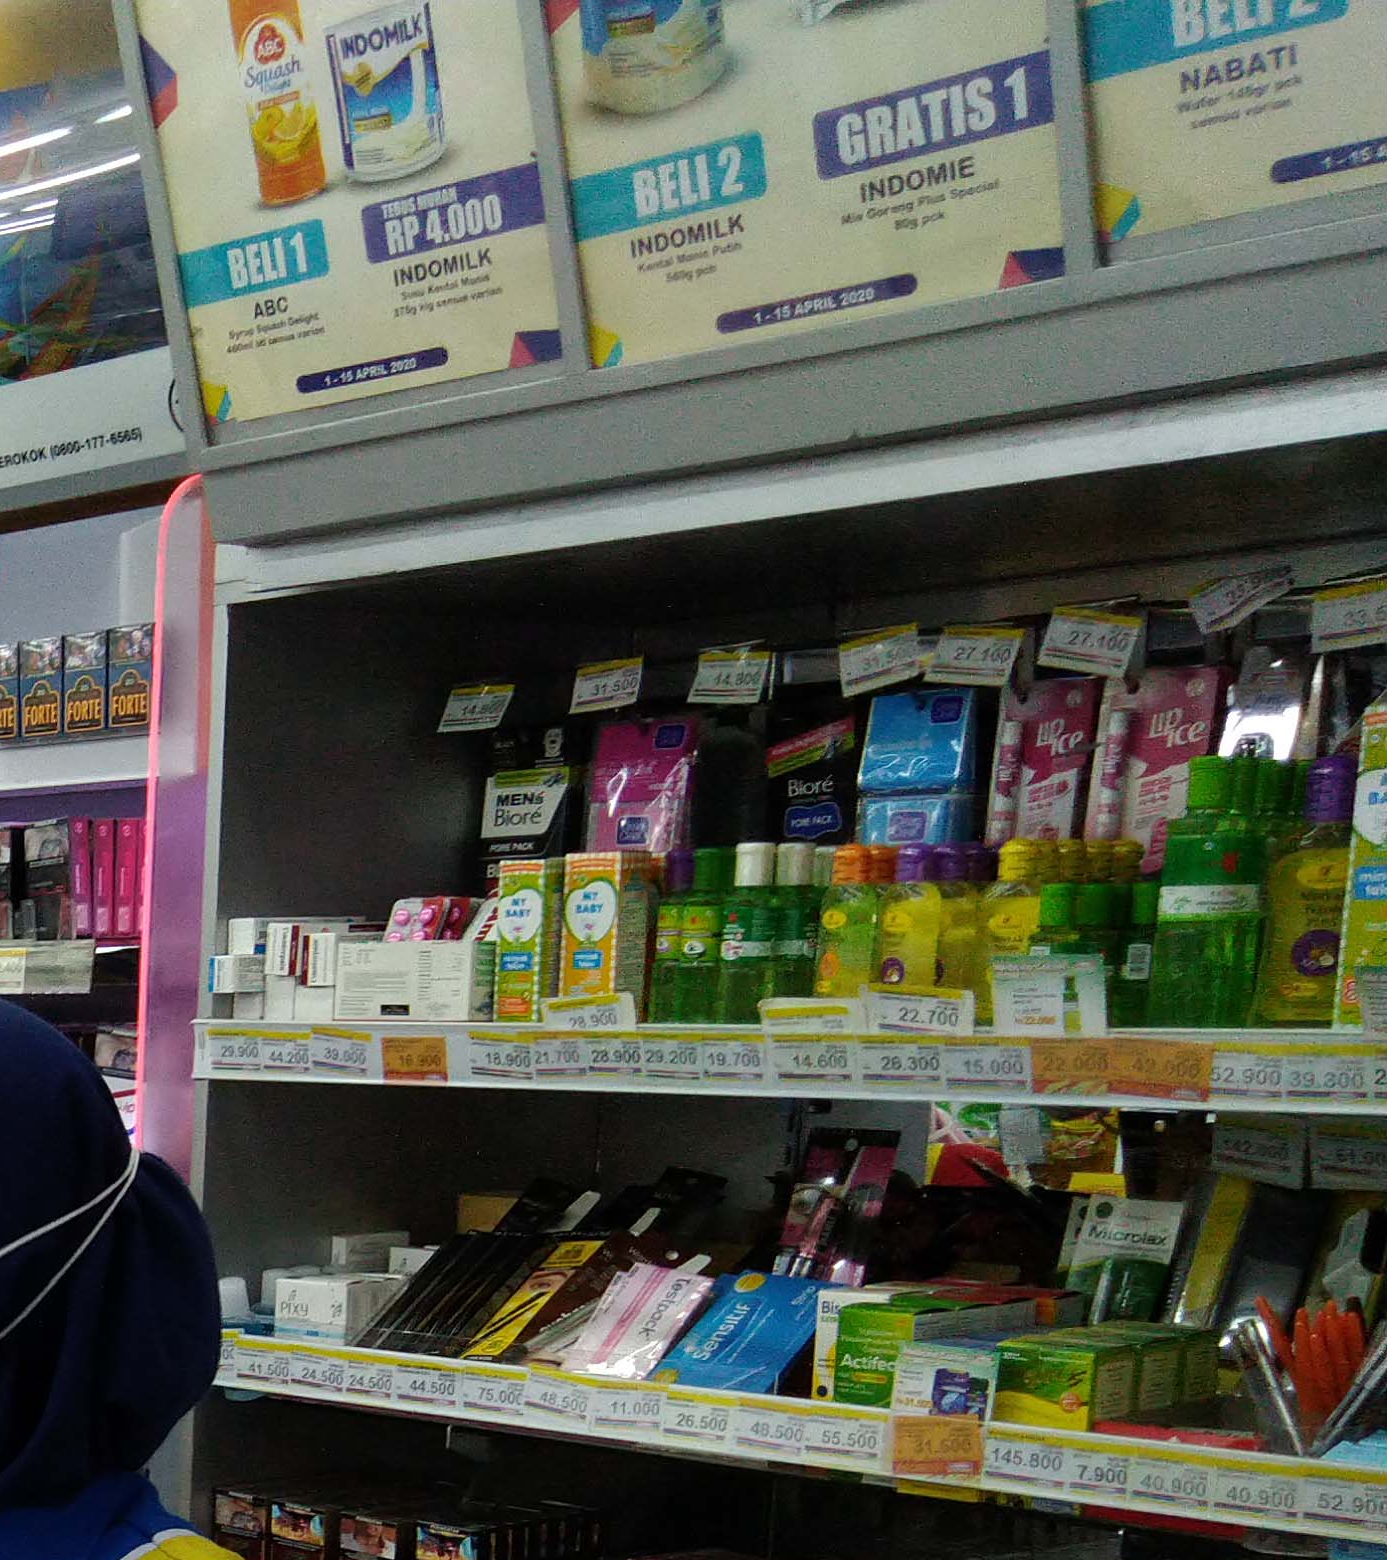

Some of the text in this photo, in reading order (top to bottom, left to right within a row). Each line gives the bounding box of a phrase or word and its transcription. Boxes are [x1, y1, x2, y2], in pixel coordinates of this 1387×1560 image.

[341, 13, 423, 59] INDOMILK
[245, 54, 300, 92] Squash
[1180, 42, 1299, 94] NABATI
[836, 66, 1028, 167] GRATIS 1
[631, 146, 745, 219] BELI 2
[860, 155, 976, 203] INDOMIE
[384, 194, 504, 256] RP 4.000
[629, 213, 746, 259] INDOMILK
[226, 231, 309, 290] BELI 1
[393, 247, 494, 287] INDOMILK
[253, 296, 289, 321] ABC
[772, 305, 793, 321] 15
[793, 298, 837, 316] APRIL
[840, 287, 876, 309] 2020
[355, 363, 390, 380] APRIL
[390, 357, 418, 371] 2020
[24, 702, 58, 725] FORTE
[67, 698, 102, 722] FORTE
[112, 692, 147, 717] FORTE
[493, 806, 543, 828] Bioré
[898, 1003, 959, 1027] 22.700
[268, 1049, 310, 1066] 44.200
[791, 1053, 848, 1070] 14.600
[963, 1057, 1025, 1075] 15.000
[1086, 1222, 1168, 1249] Microlax
[638, 1277, 692, 1339] Testpack
[300, 1366, 344, 1386] 24.500
[409, 1378, 456, 1396] 44.500
[608, 1399, 661, 1418] 11.000
[675, 1412, 729, 1433] 26.500
[820, 1429, 879, 1451] 55.500
[990, 1445, 1063, 1472] 145.800
[1075, 1463, 1129, 1487] 7.900
[1138, 1473, 1209, 1500] 40.900
[1226, 1485, 1297, 1510] 40.900
